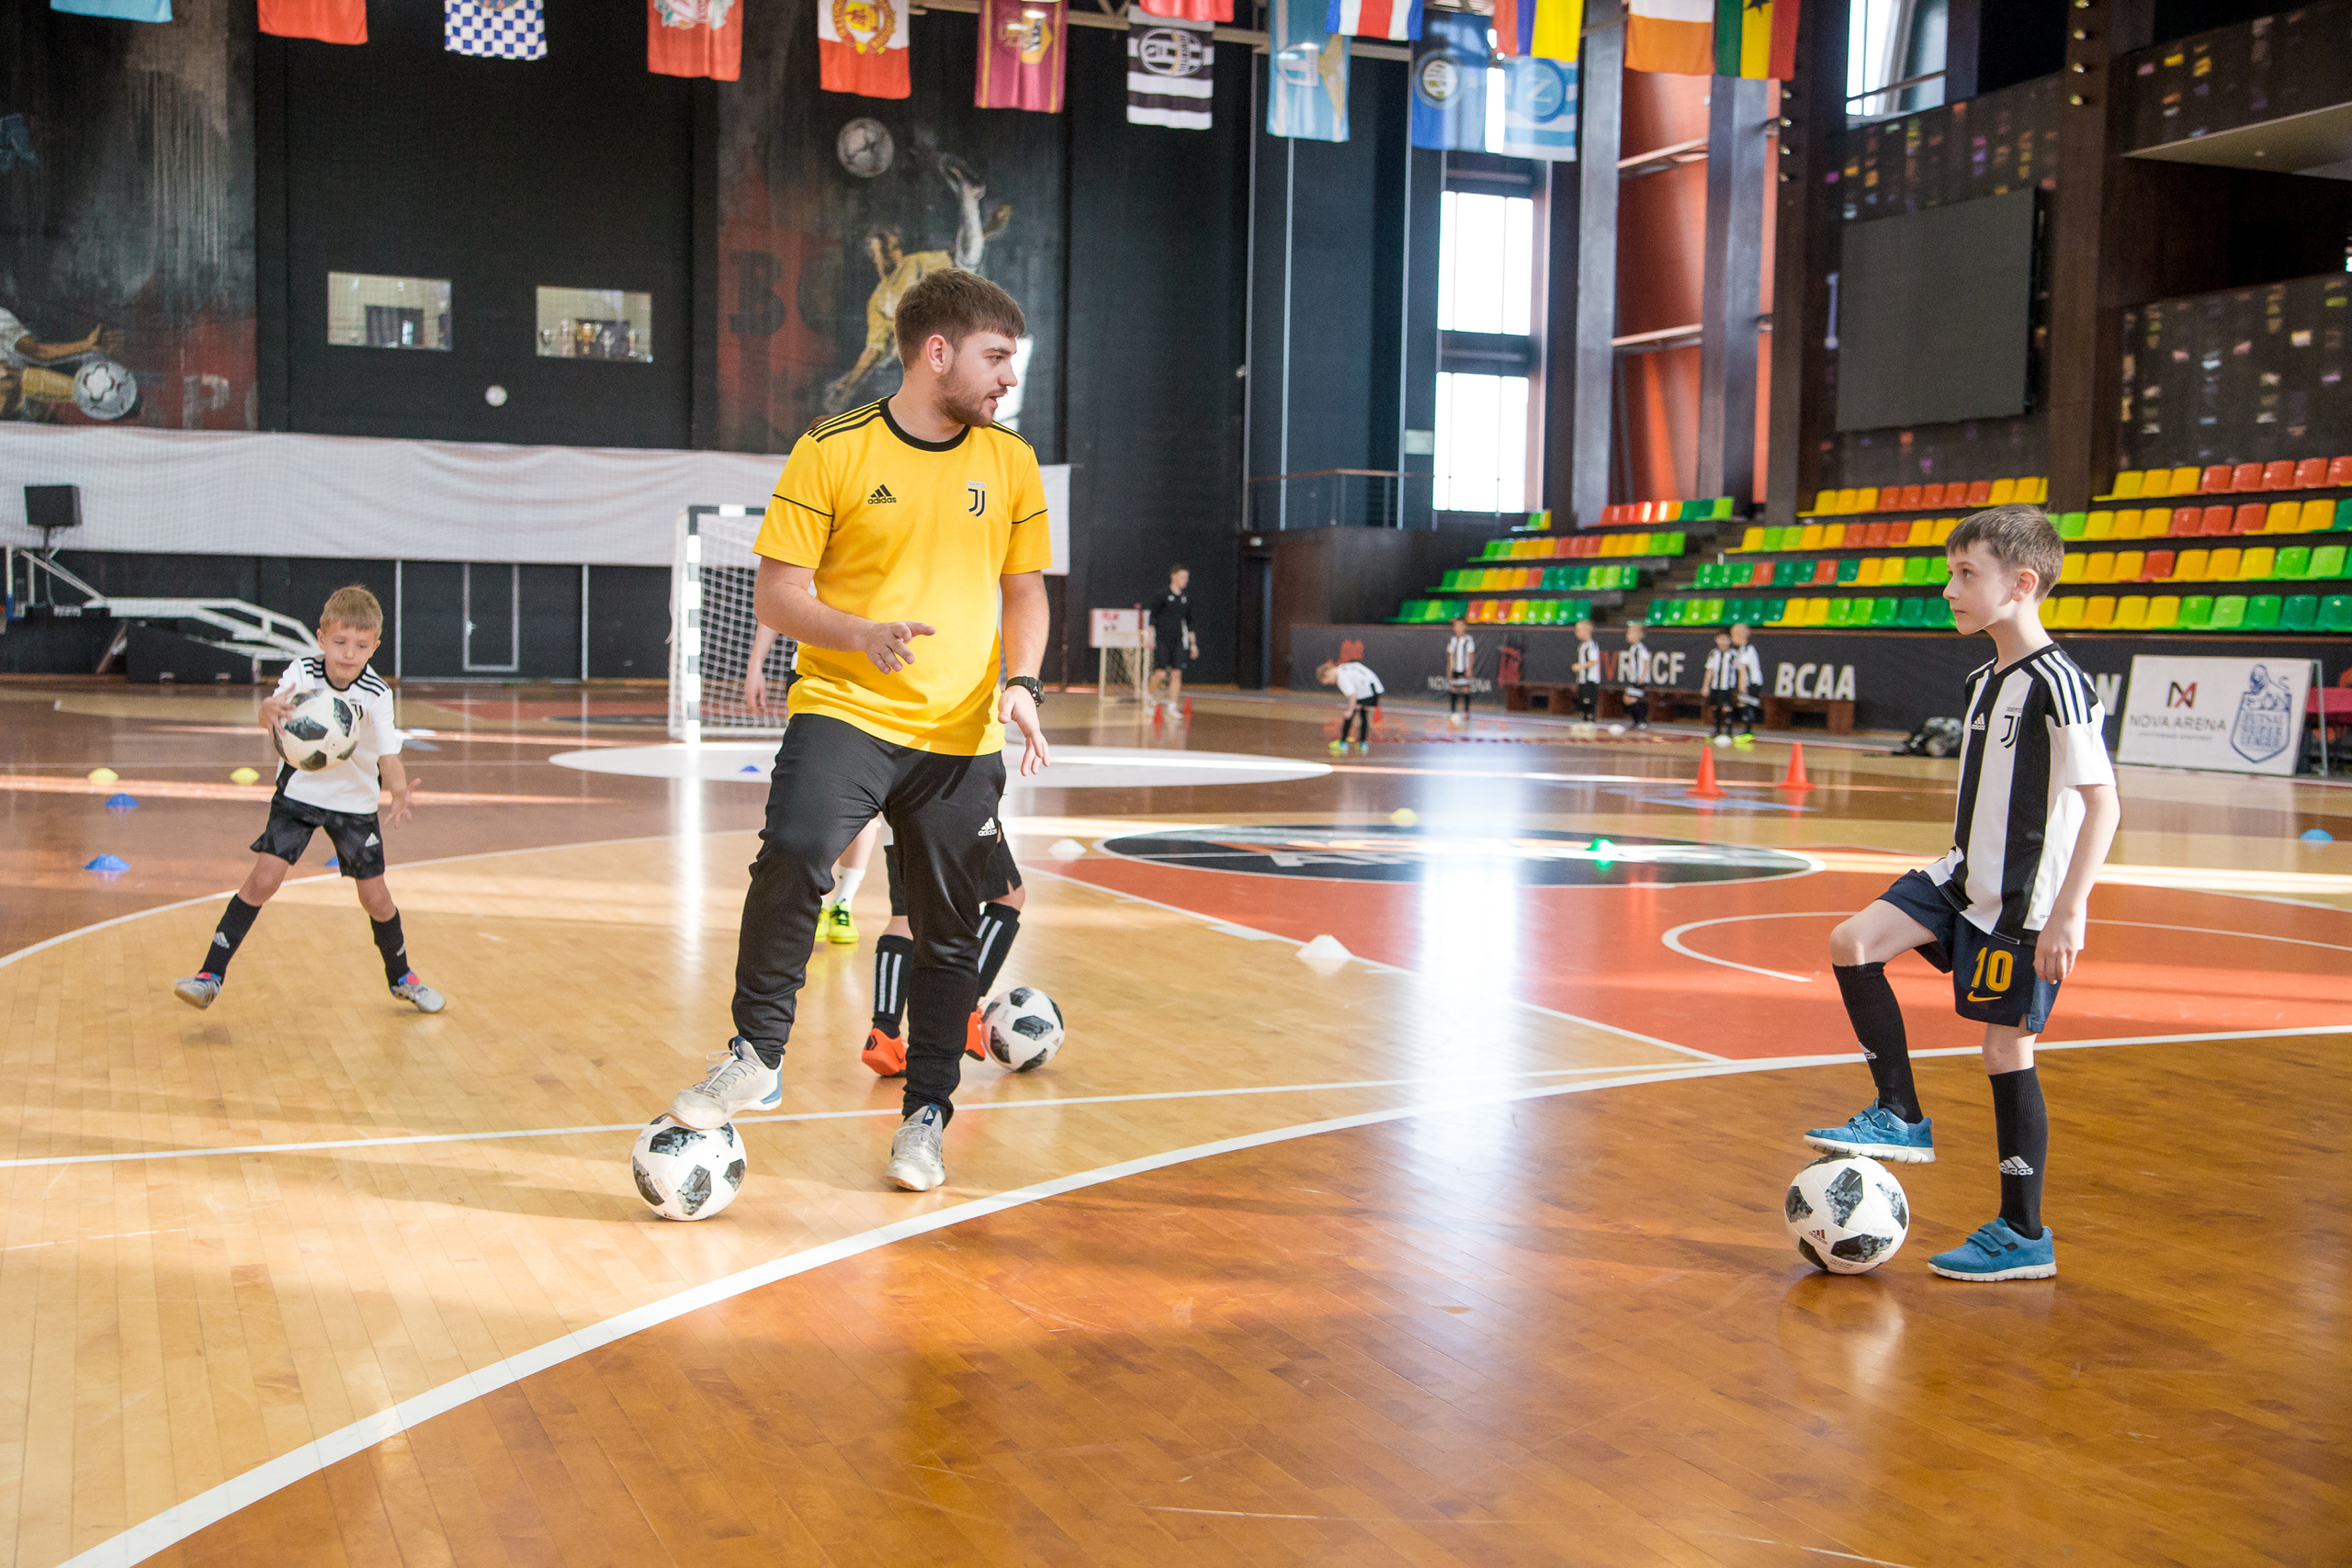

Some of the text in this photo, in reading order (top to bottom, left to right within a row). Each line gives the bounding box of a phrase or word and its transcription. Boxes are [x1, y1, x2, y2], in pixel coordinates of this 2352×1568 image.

[867, 496, 898, 505] adidas
[1774, 661, 1856, 701] BCAA
[2129, 714, 2227, 732] NOVA ARENA
[1971, 946, 2014, 992] 10
